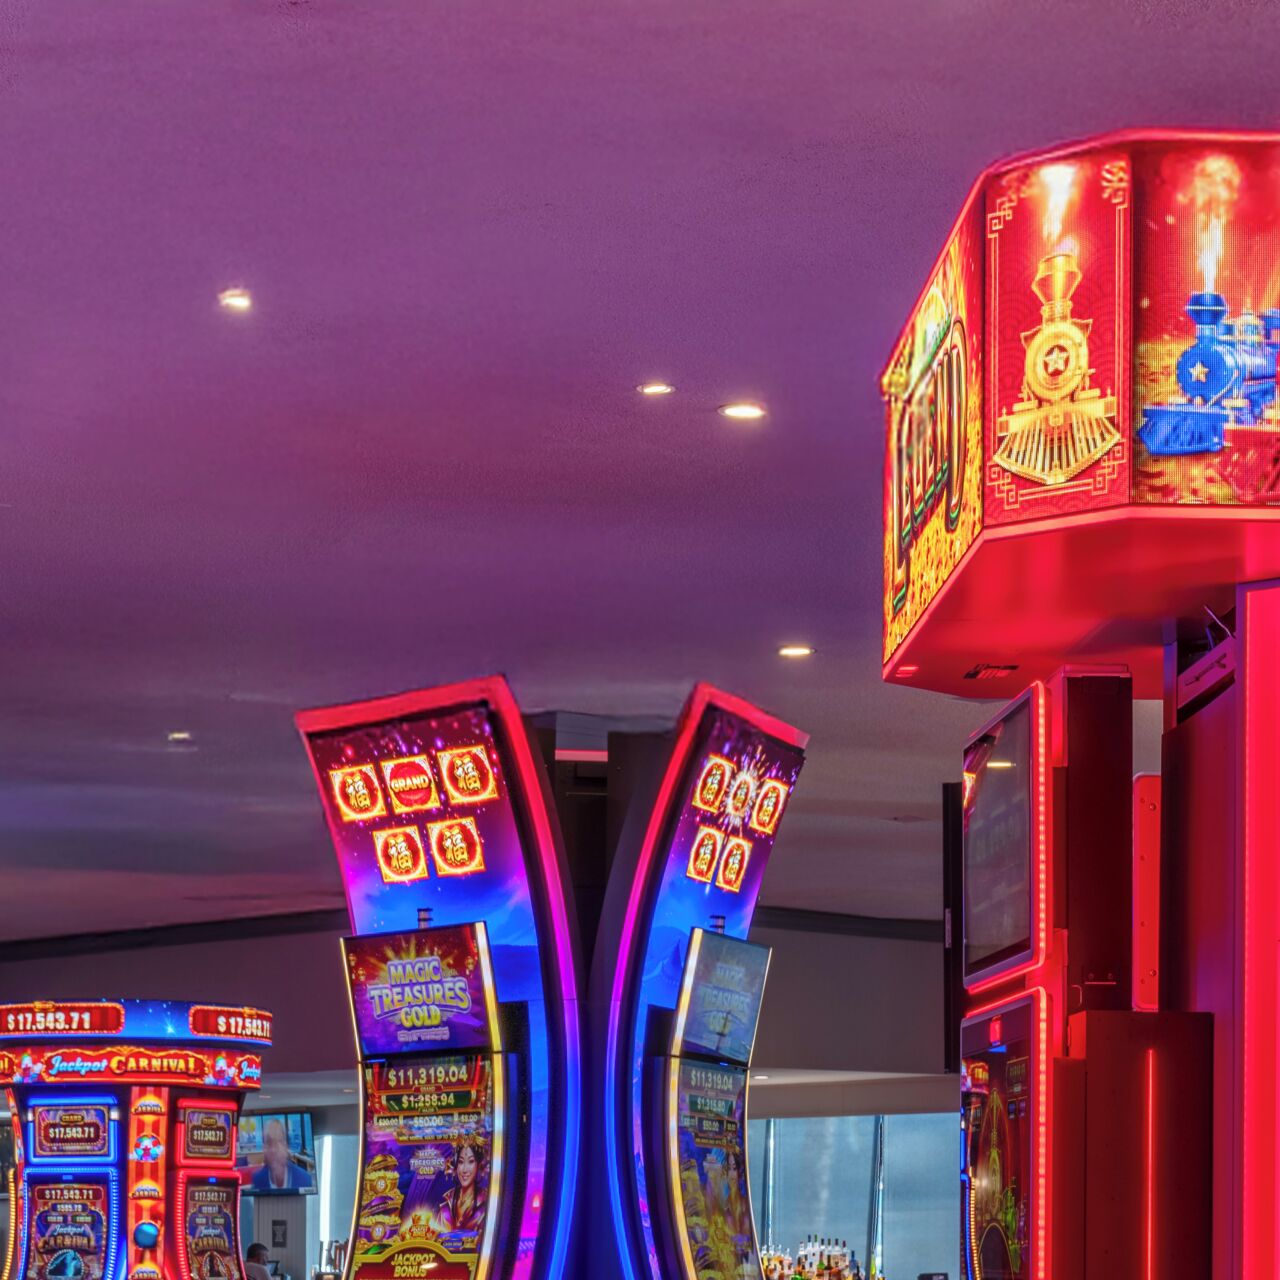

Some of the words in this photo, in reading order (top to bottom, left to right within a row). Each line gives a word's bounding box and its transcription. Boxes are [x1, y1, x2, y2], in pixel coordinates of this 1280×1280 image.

[892, 316, 968, 614] LEGEND
[390, 776, 429, 791] GRAND
[389, 957, 441, 984] MAGIC
[371, 980, 470, 1015] TREASURES
[7, 1012, 91, 1031] $17,543.71
[401, 1005, 441, 1027] GOLD
[49, 1056, 109, 1076] Jackpot
[109, 1056, 201, 1075] CARNIVAL
[388, 1065, 468, 1087] $11,319.04
[402, 1093, 455, 1109] $1,258.94
[391, 1253, 436, 1266] JACKPOT
[394, 1266, 428, 1277] BONUS
